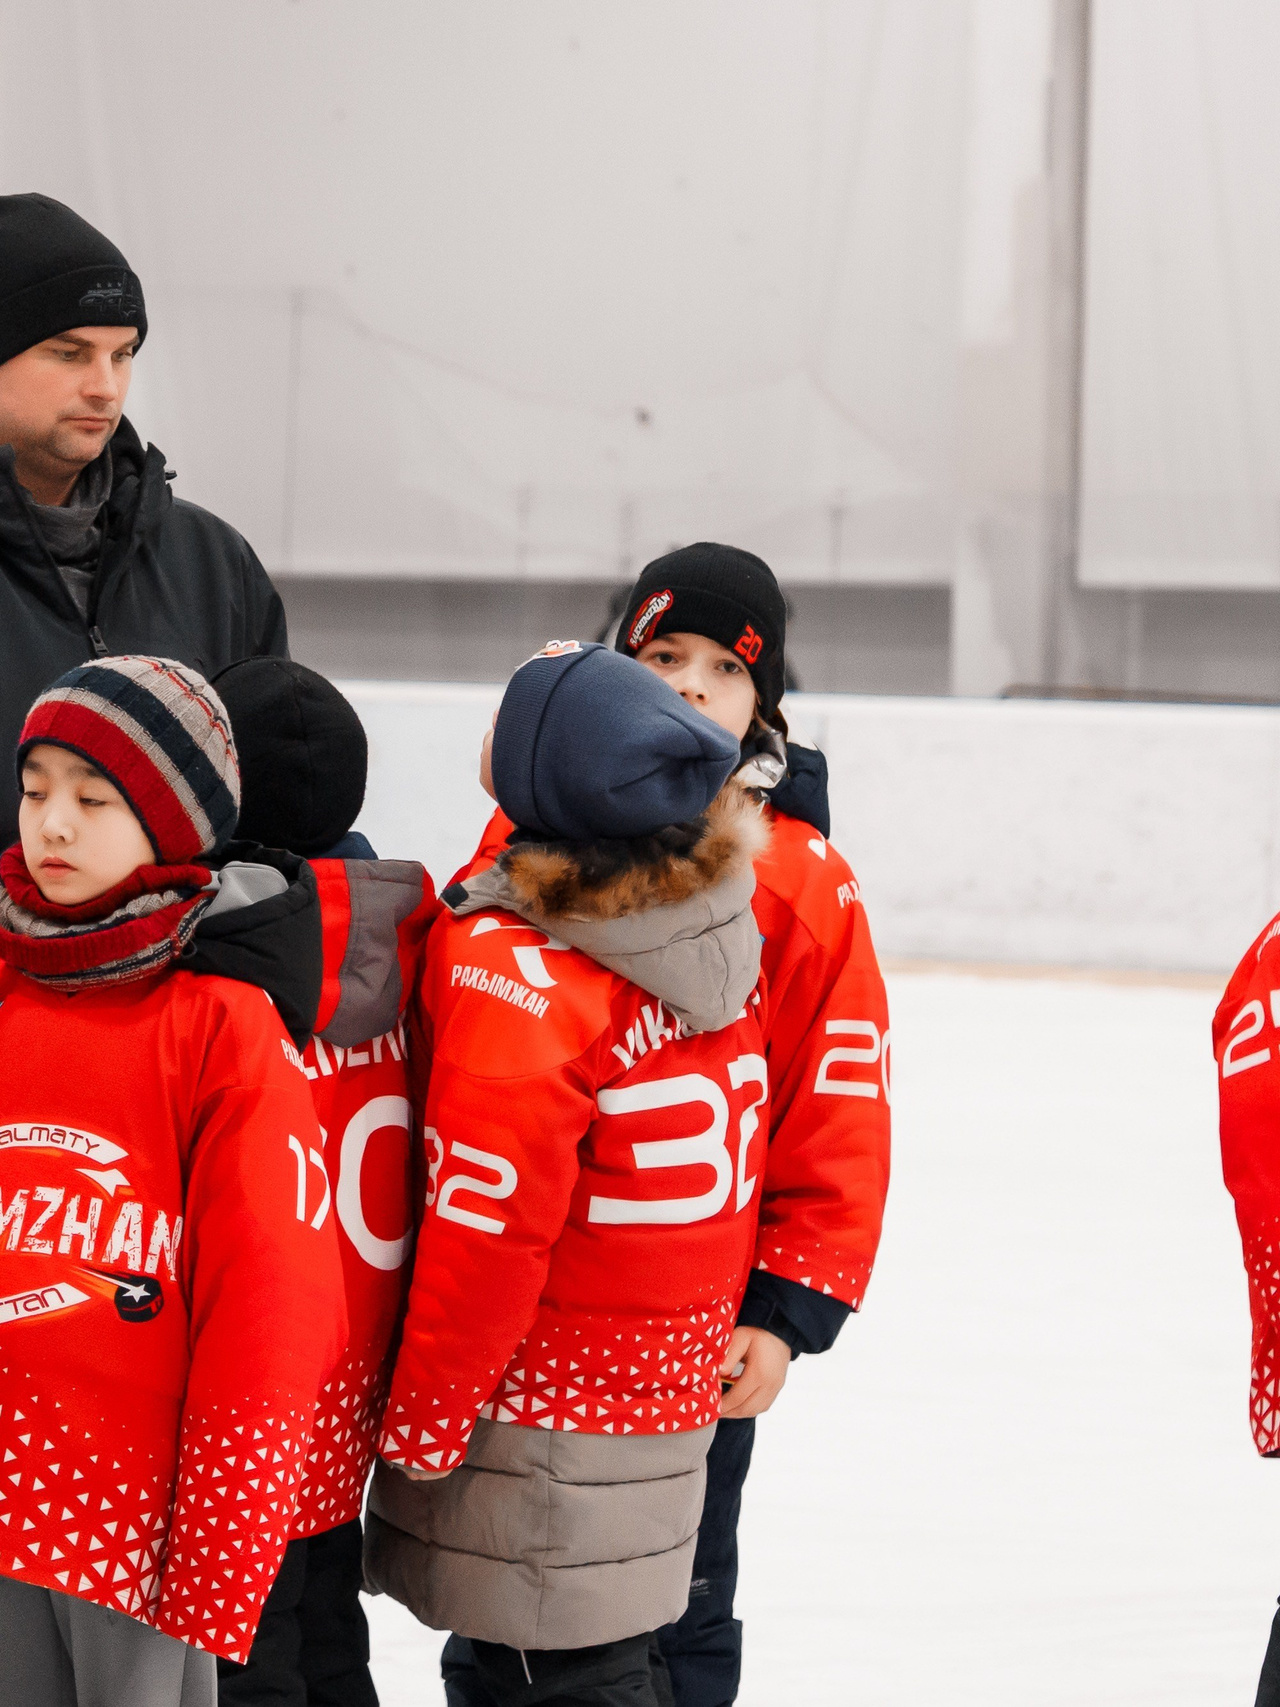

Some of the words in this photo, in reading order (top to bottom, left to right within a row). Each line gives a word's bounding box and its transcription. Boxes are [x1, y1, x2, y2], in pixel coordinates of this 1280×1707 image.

[734, 625, 763, 665] 20
[451, 964, 551, 1020] РАХЫМЖАН
[423, 1125, 519, 1236] 32
[587, 1053, 769, 1226] 32
